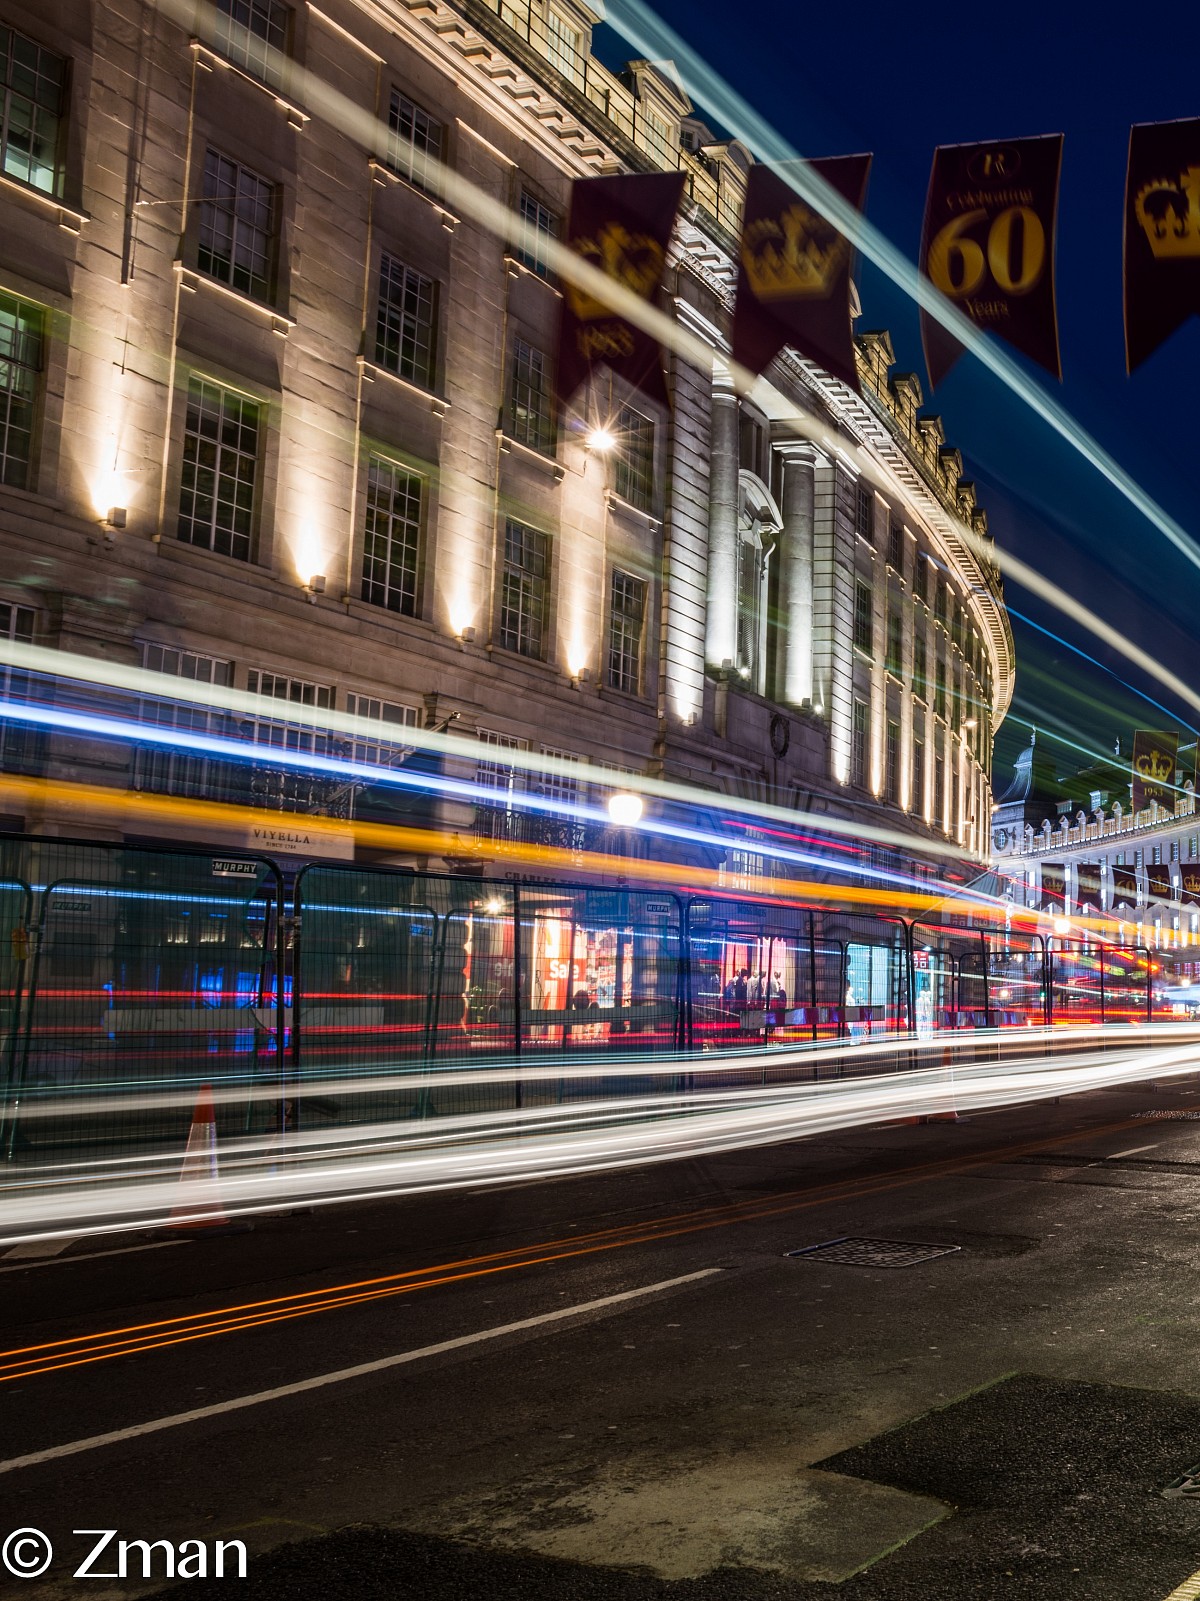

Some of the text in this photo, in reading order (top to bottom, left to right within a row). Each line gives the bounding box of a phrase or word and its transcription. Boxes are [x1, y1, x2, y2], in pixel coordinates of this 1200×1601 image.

[927, 206, 1046, 297] 60
[966, 299, 1010, 318] Years
[1143, 786, 1164, 797] 1953
[254, 828, 310, 844] VIYELLA
[214, 862, 256, 873] MURPHY
[549, 959, 580, 979] Sale
